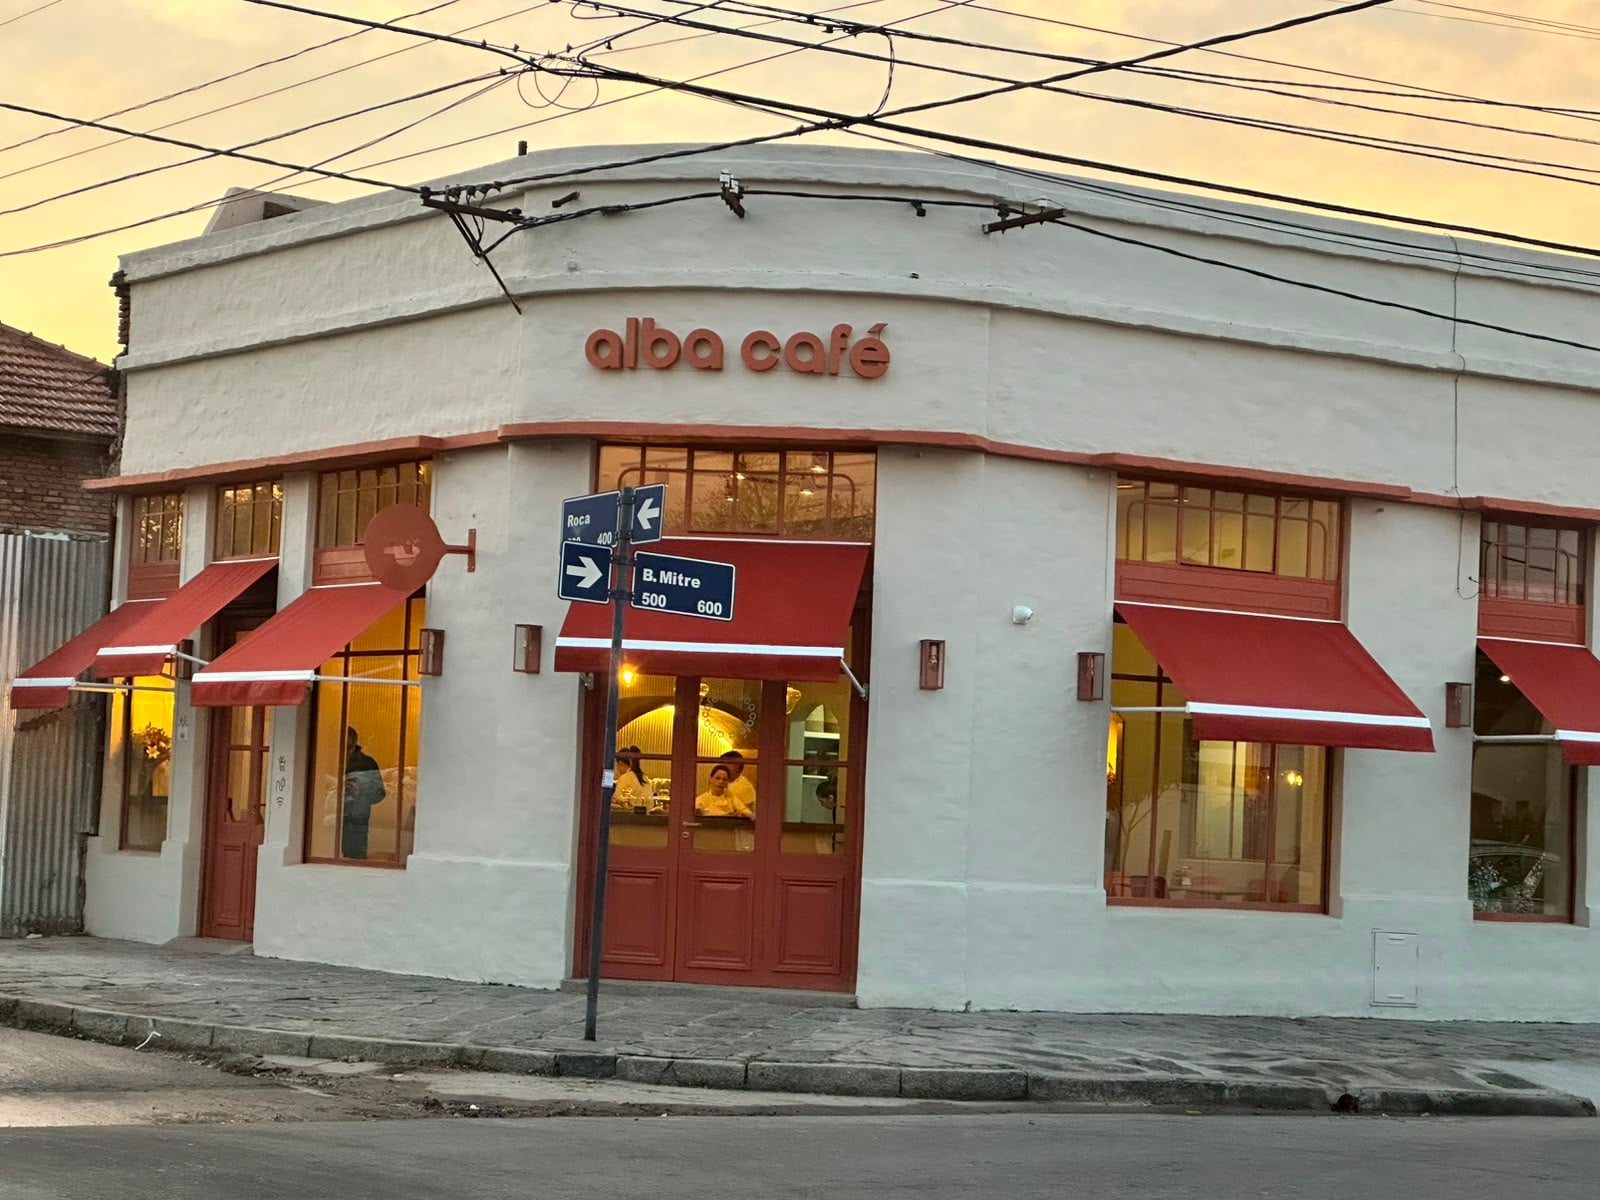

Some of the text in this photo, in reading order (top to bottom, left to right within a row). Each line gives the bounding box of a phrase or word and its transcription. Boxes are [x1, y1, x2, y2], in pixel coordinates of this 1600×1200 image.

[584, 317, 890, 379] alba café
[567, 514, 590, 528] Roca
[597, 531, 613, 545] 400
[642, 568, 701, 589] B. Mitre
[641, 592, 722, 616] 500 600
